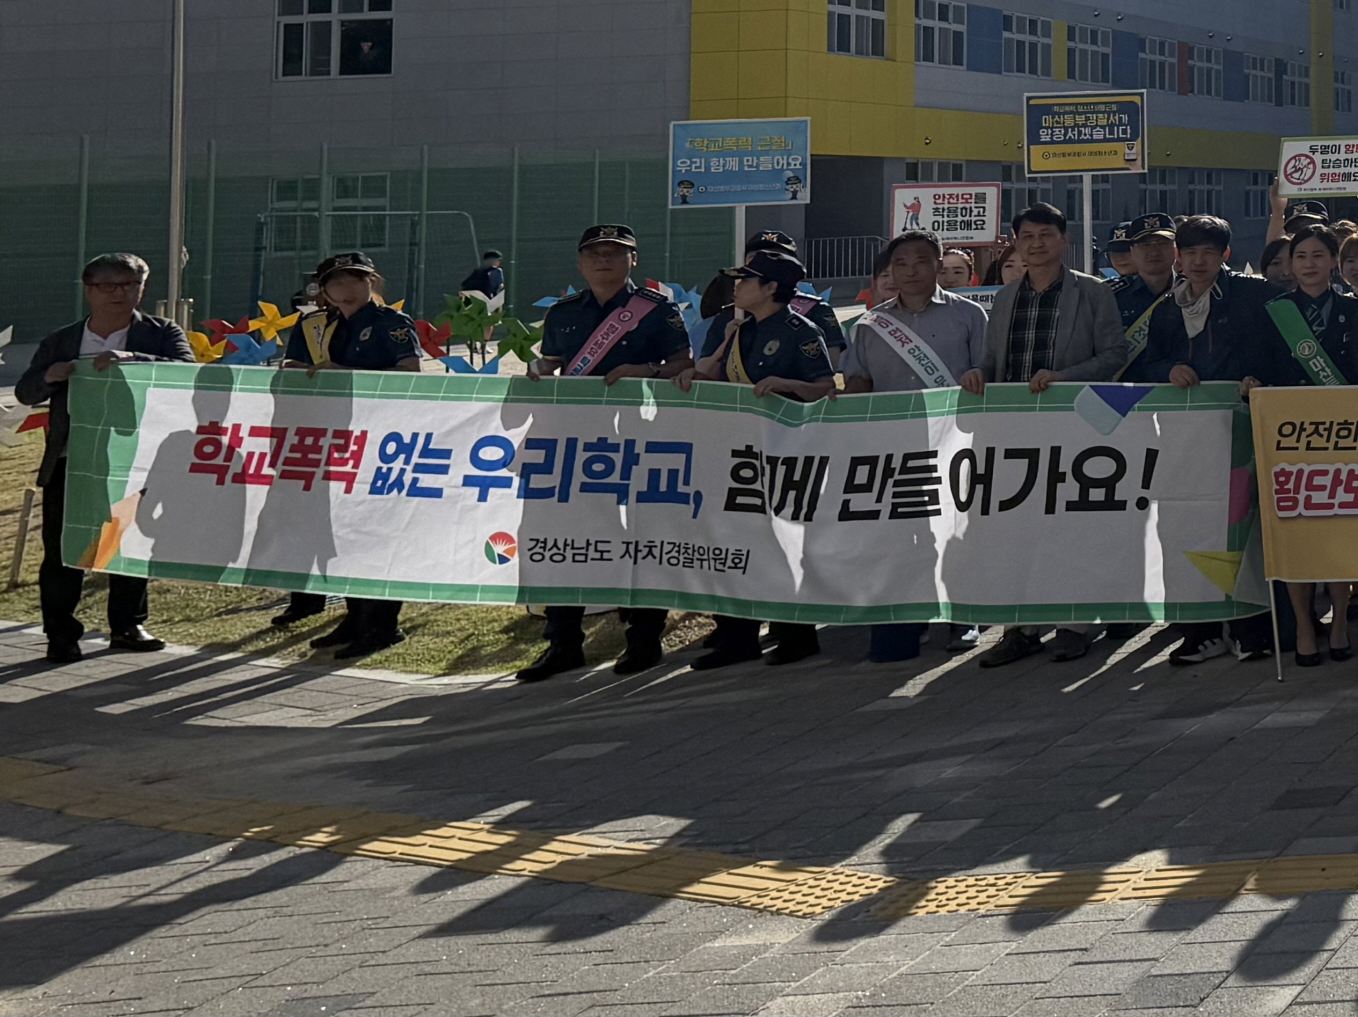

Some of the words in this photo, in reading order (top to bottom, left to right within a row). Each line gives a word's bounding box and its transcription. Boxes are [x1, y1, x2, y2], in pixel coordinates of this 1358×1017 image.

[1041, 112, 1129, 127] 마산동부경찰서가
[1039, 126, 1131, 142] 앞장서겠습니다
[1308, 144, 1341, 156] 두명이
[676, 157, 705, 173] 우리
[710, 156, 739, 173] 함께
[743, 155, 803, 171] 만들어요
[932, 192, 987, 205] 안전모를
[932, 206, 987, 218] 착용하고
[188, 420, 368, 494] 학교폭력
[368, 430, 454, 499] 없는
[461, 432, 704, 521] 우리학교,
[723, 443, 831, 523] 함께
[837, 444, 1160, 523] 만들어가요!
[527, 537, 614, 564] 경상남도
[619, 539, 751, 575] 자치경찰위원회
